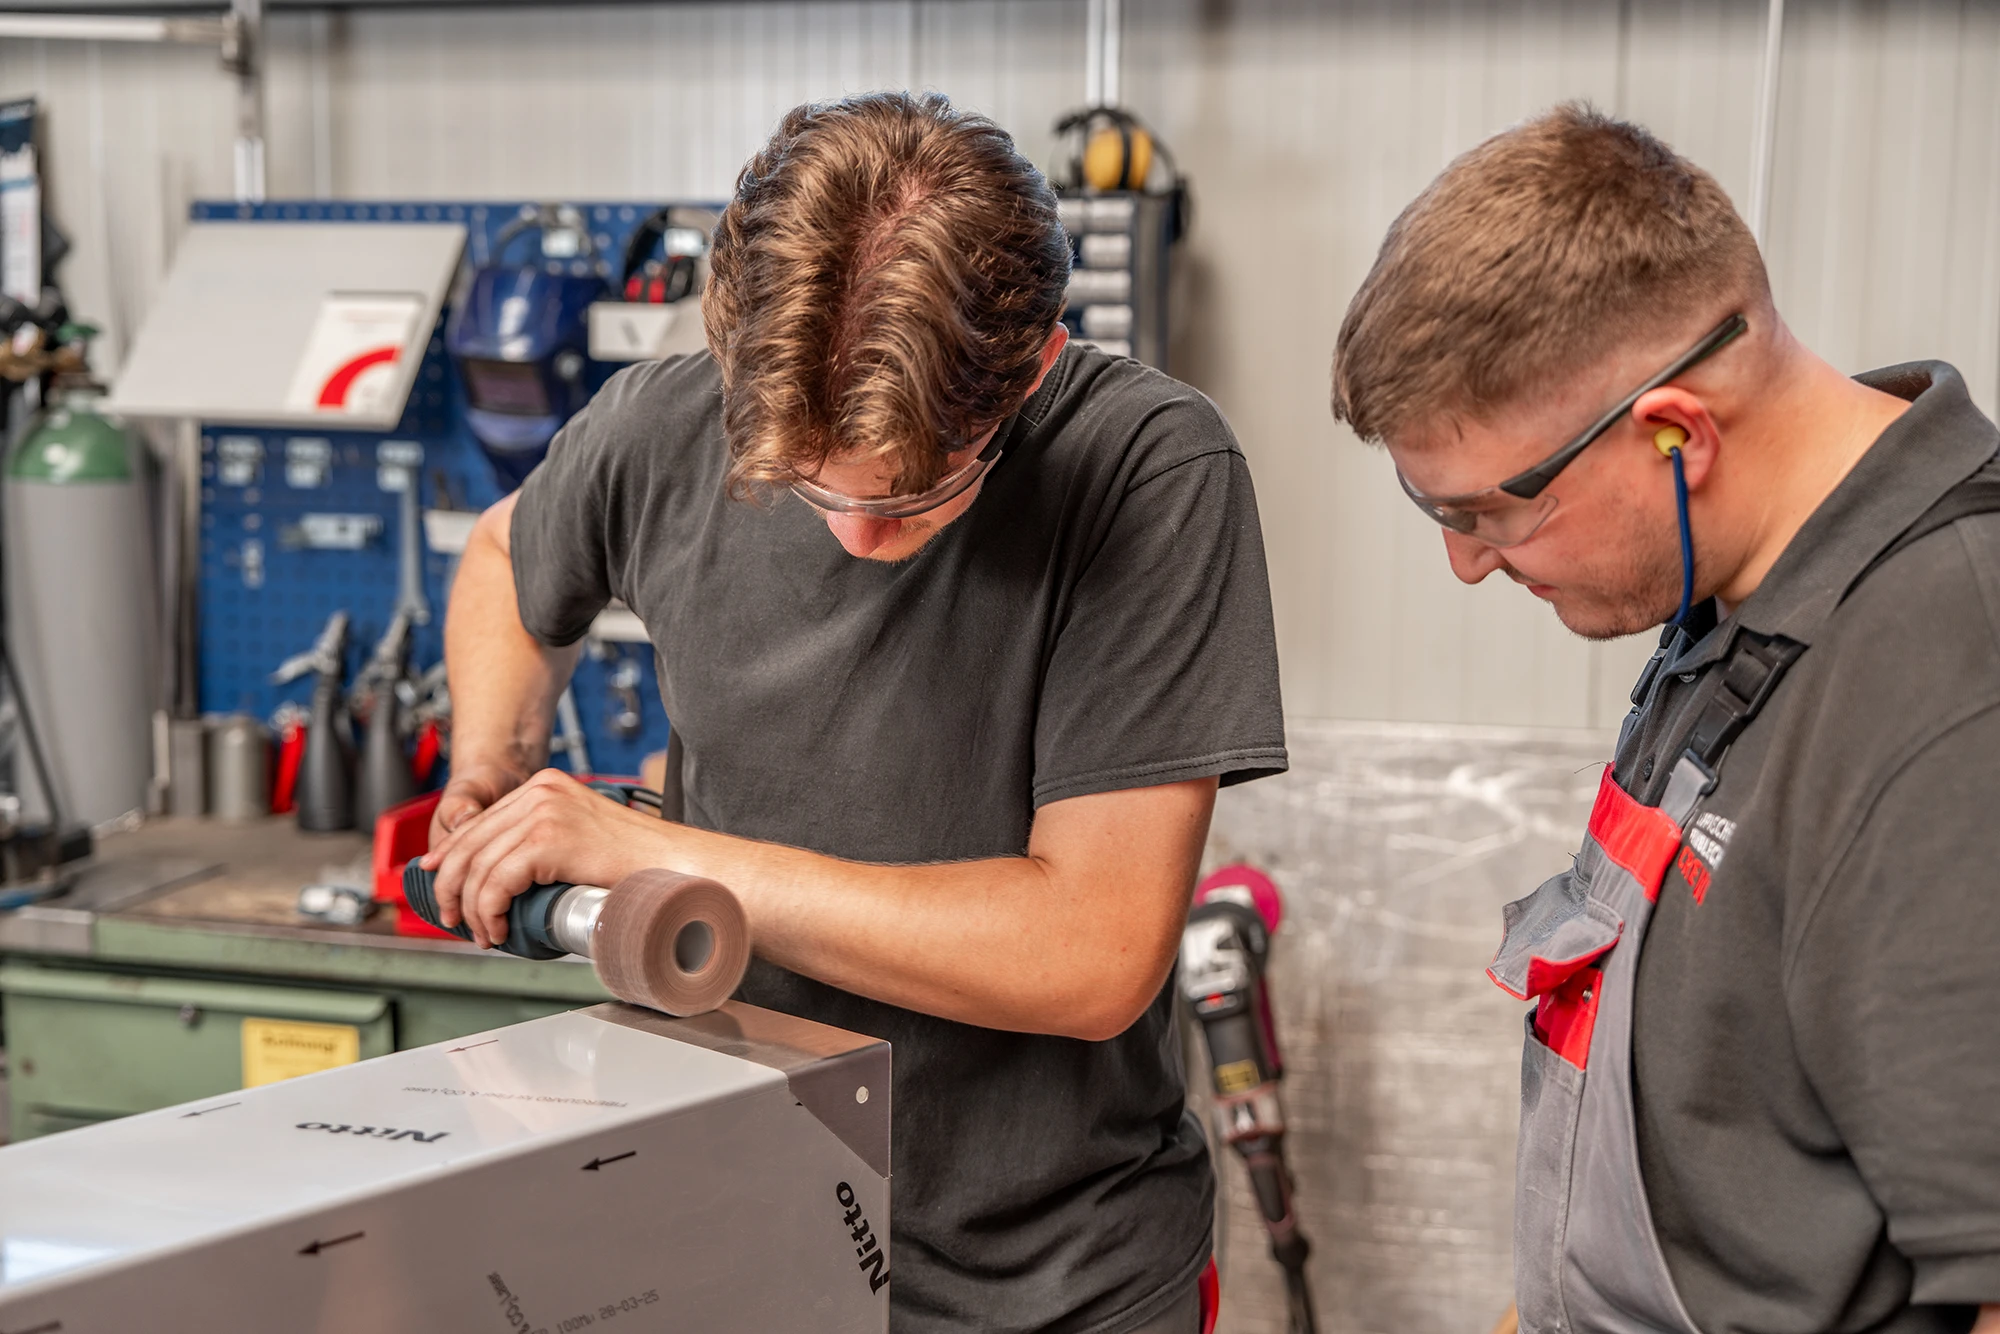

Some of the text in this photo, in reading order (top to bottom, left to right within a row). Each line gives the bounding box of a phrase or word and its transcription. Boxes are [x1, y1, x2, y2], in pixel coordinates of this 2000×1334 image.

[1677, 845, 1712, 907] CREW
[401, 1086, 438, 1094] Laser
[296, 1122, 450, 1142] Nitto
[836, 1181, 891, 1296] Nitto
[598, 1289, 660, 1320] 28-03-25
